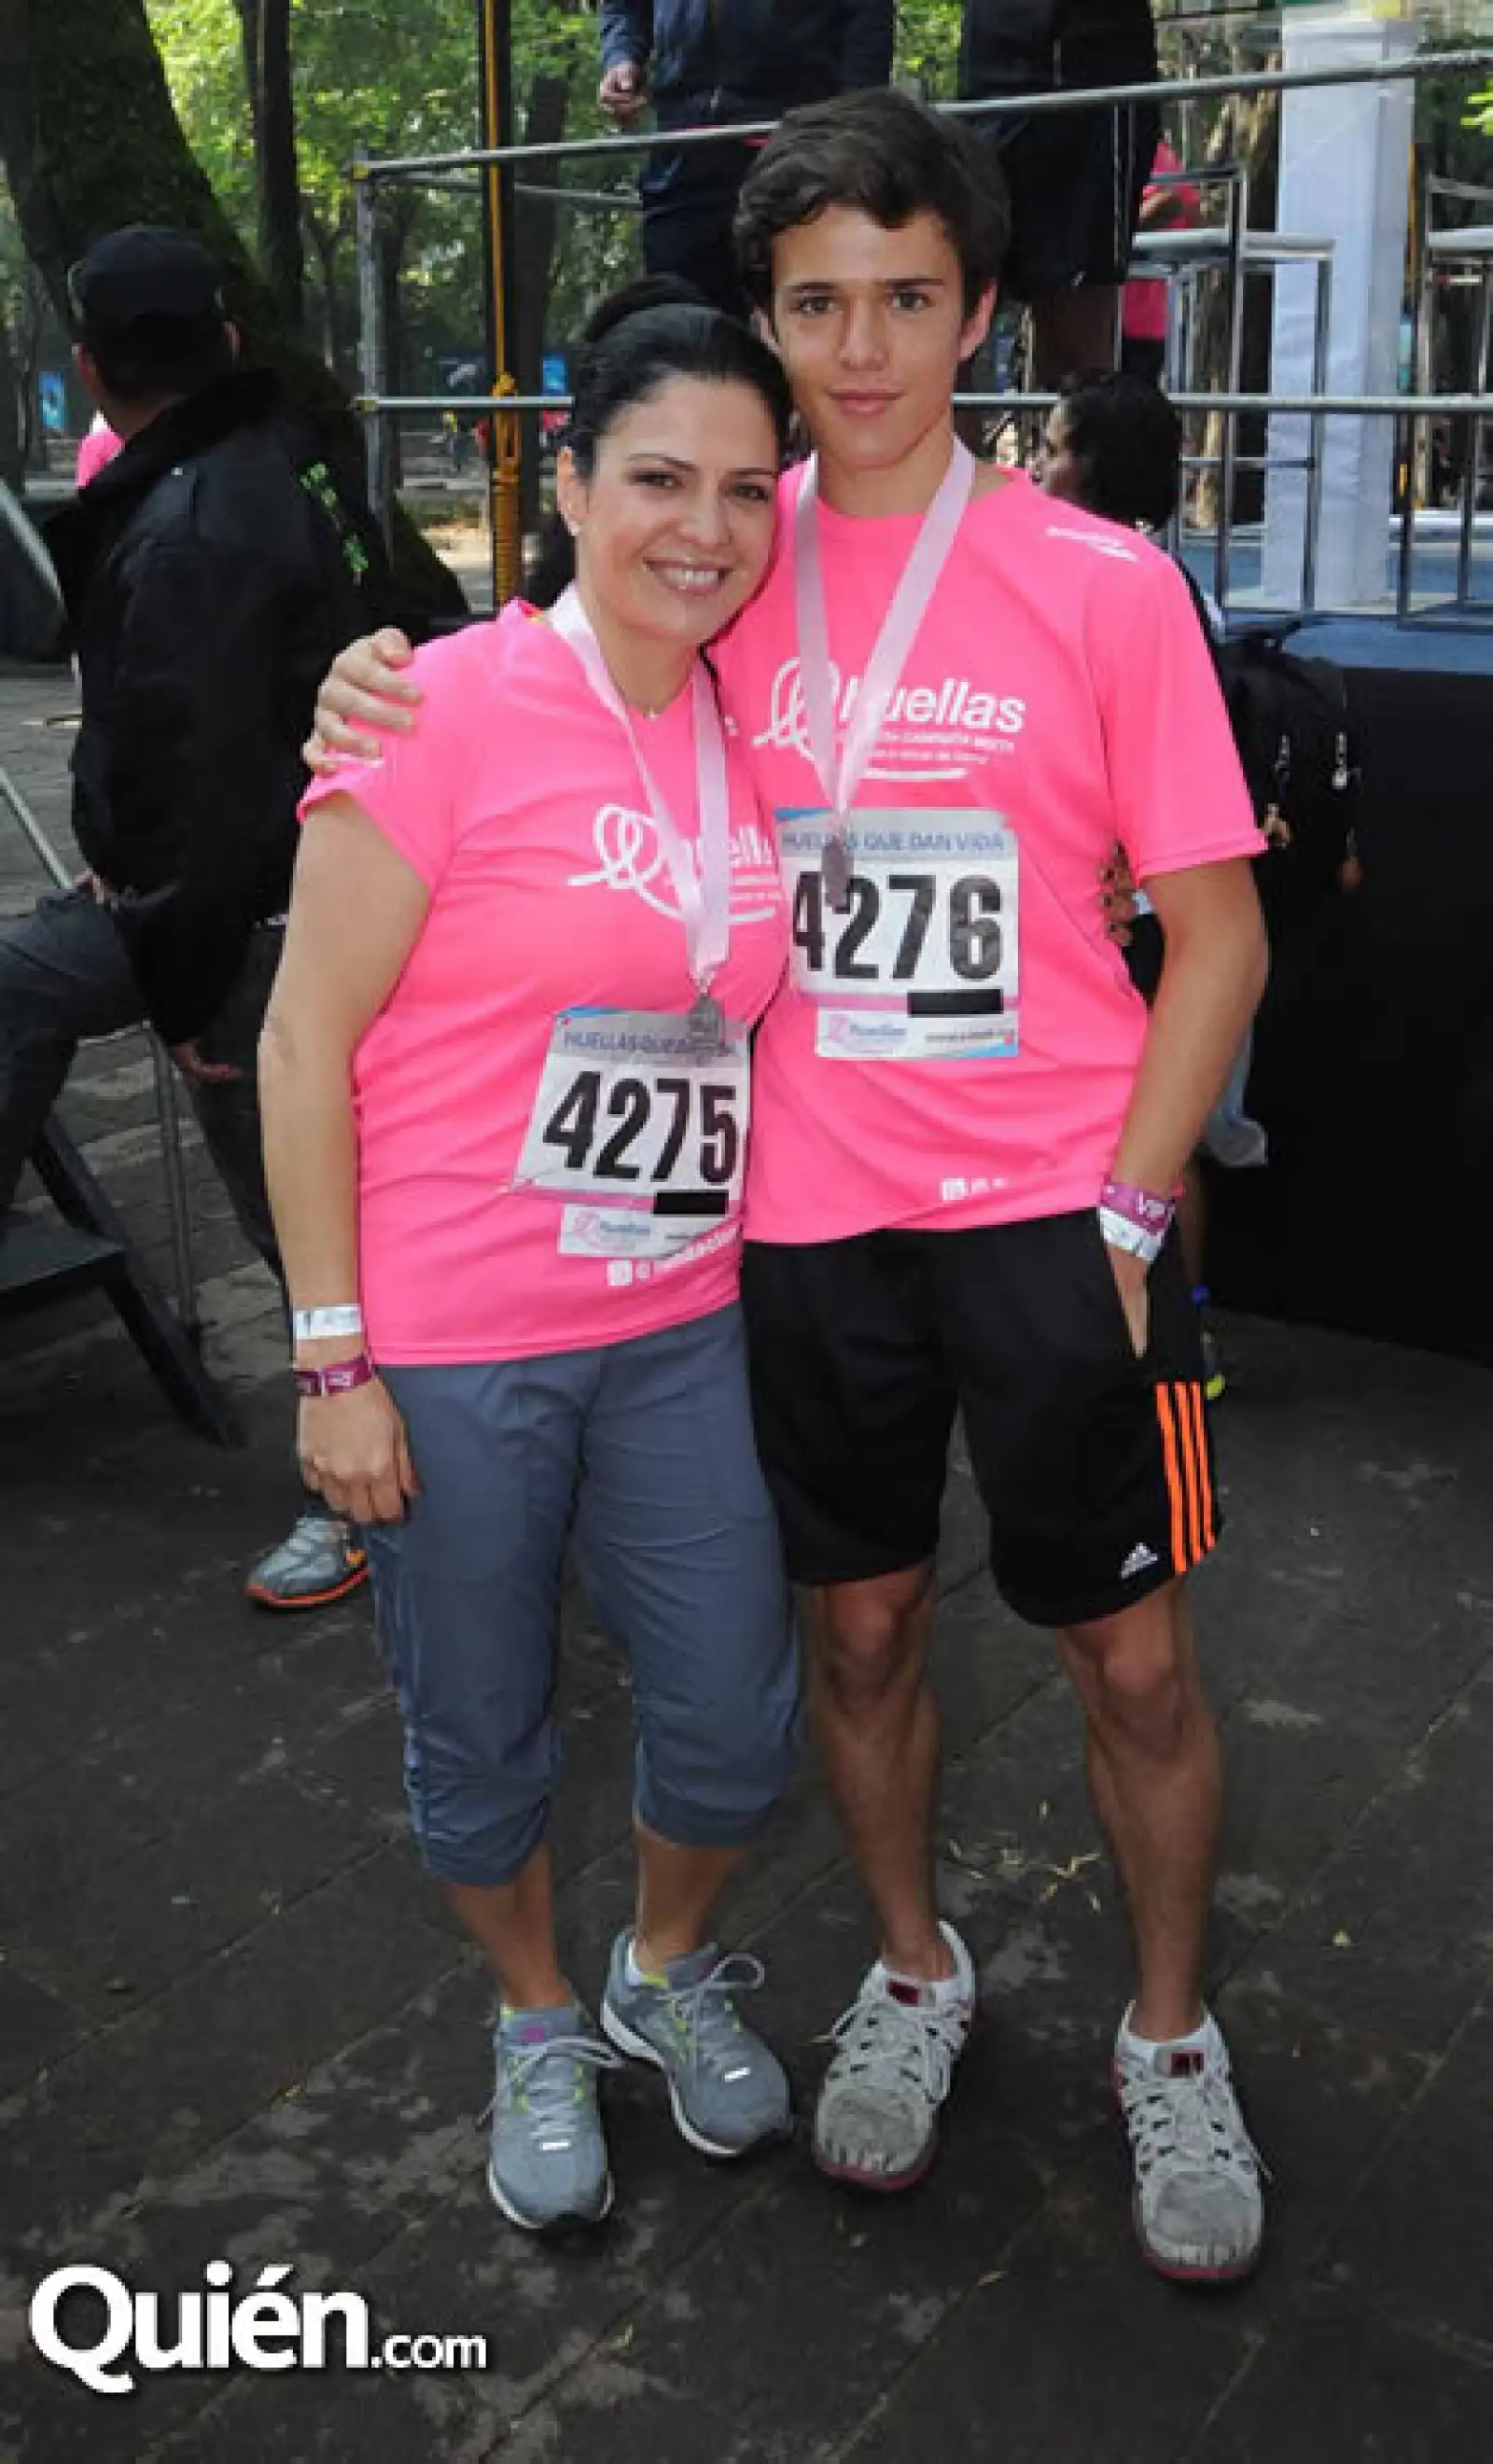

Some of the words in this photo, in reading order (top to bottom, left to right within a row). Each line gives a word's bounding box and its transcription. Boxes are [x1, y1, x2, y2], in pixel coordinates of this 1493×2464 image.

[782, 829, 858, 851] HUELS
[793, 871, 1004, 981] 4276
[543, 1071, 737, 1185] 4275
